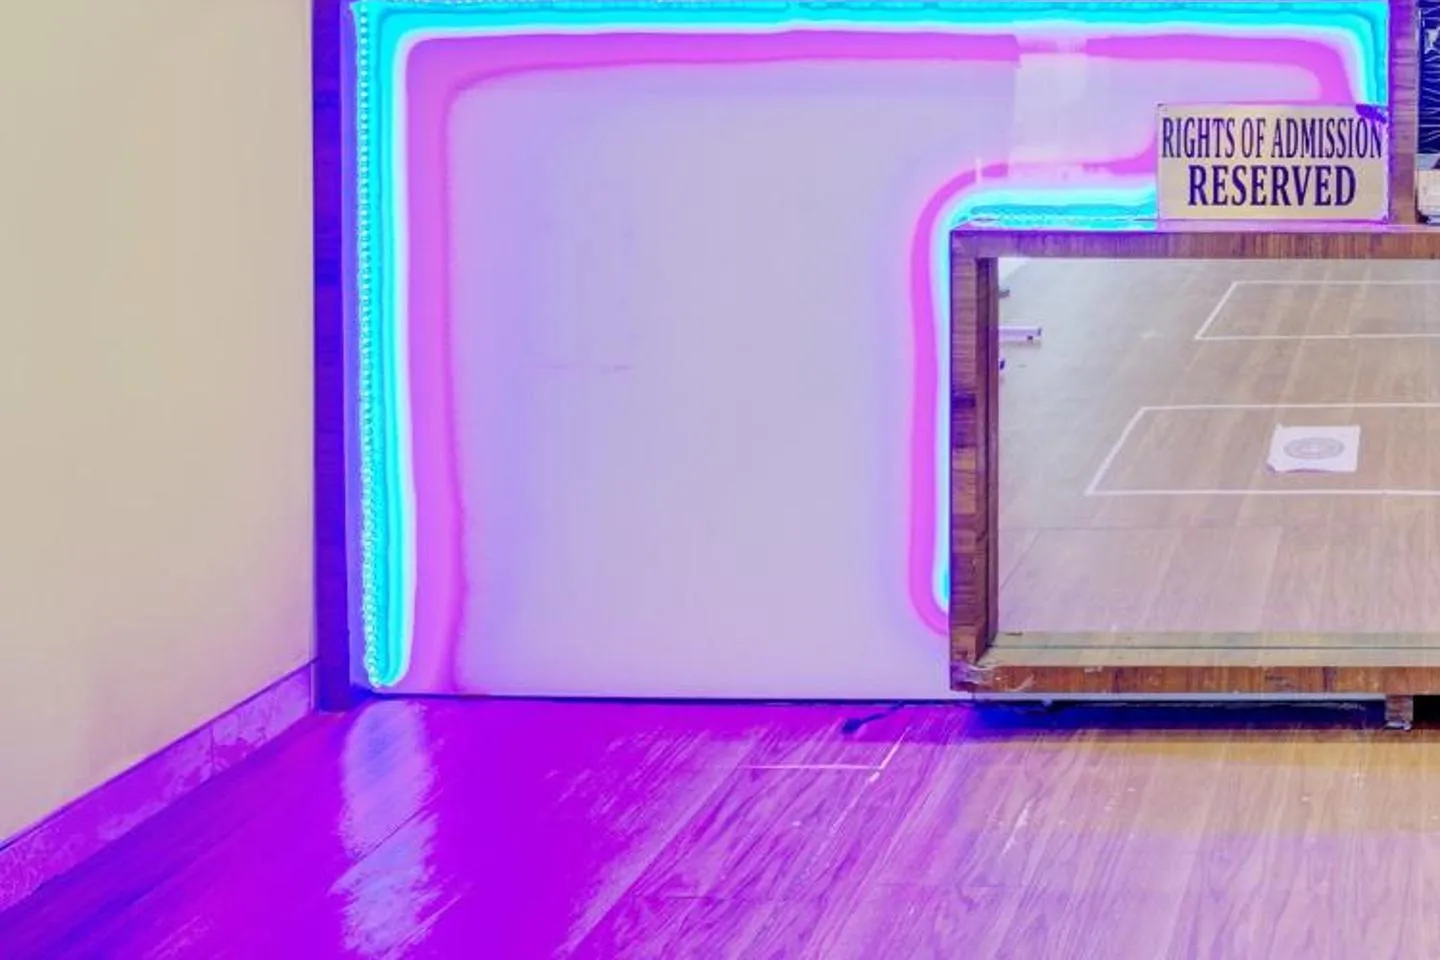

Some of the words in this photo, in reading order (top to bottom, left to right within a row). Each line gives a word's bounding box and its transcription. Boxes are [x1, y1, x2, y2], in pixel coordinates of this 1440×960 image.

[1162, 117, 1236, 159] RIGHTS
[1241, 117, 1266, 159] OF
[1270, 117, 1383, 160] ADMISSION
[1188, 165, 1356, 207] RESERVED
